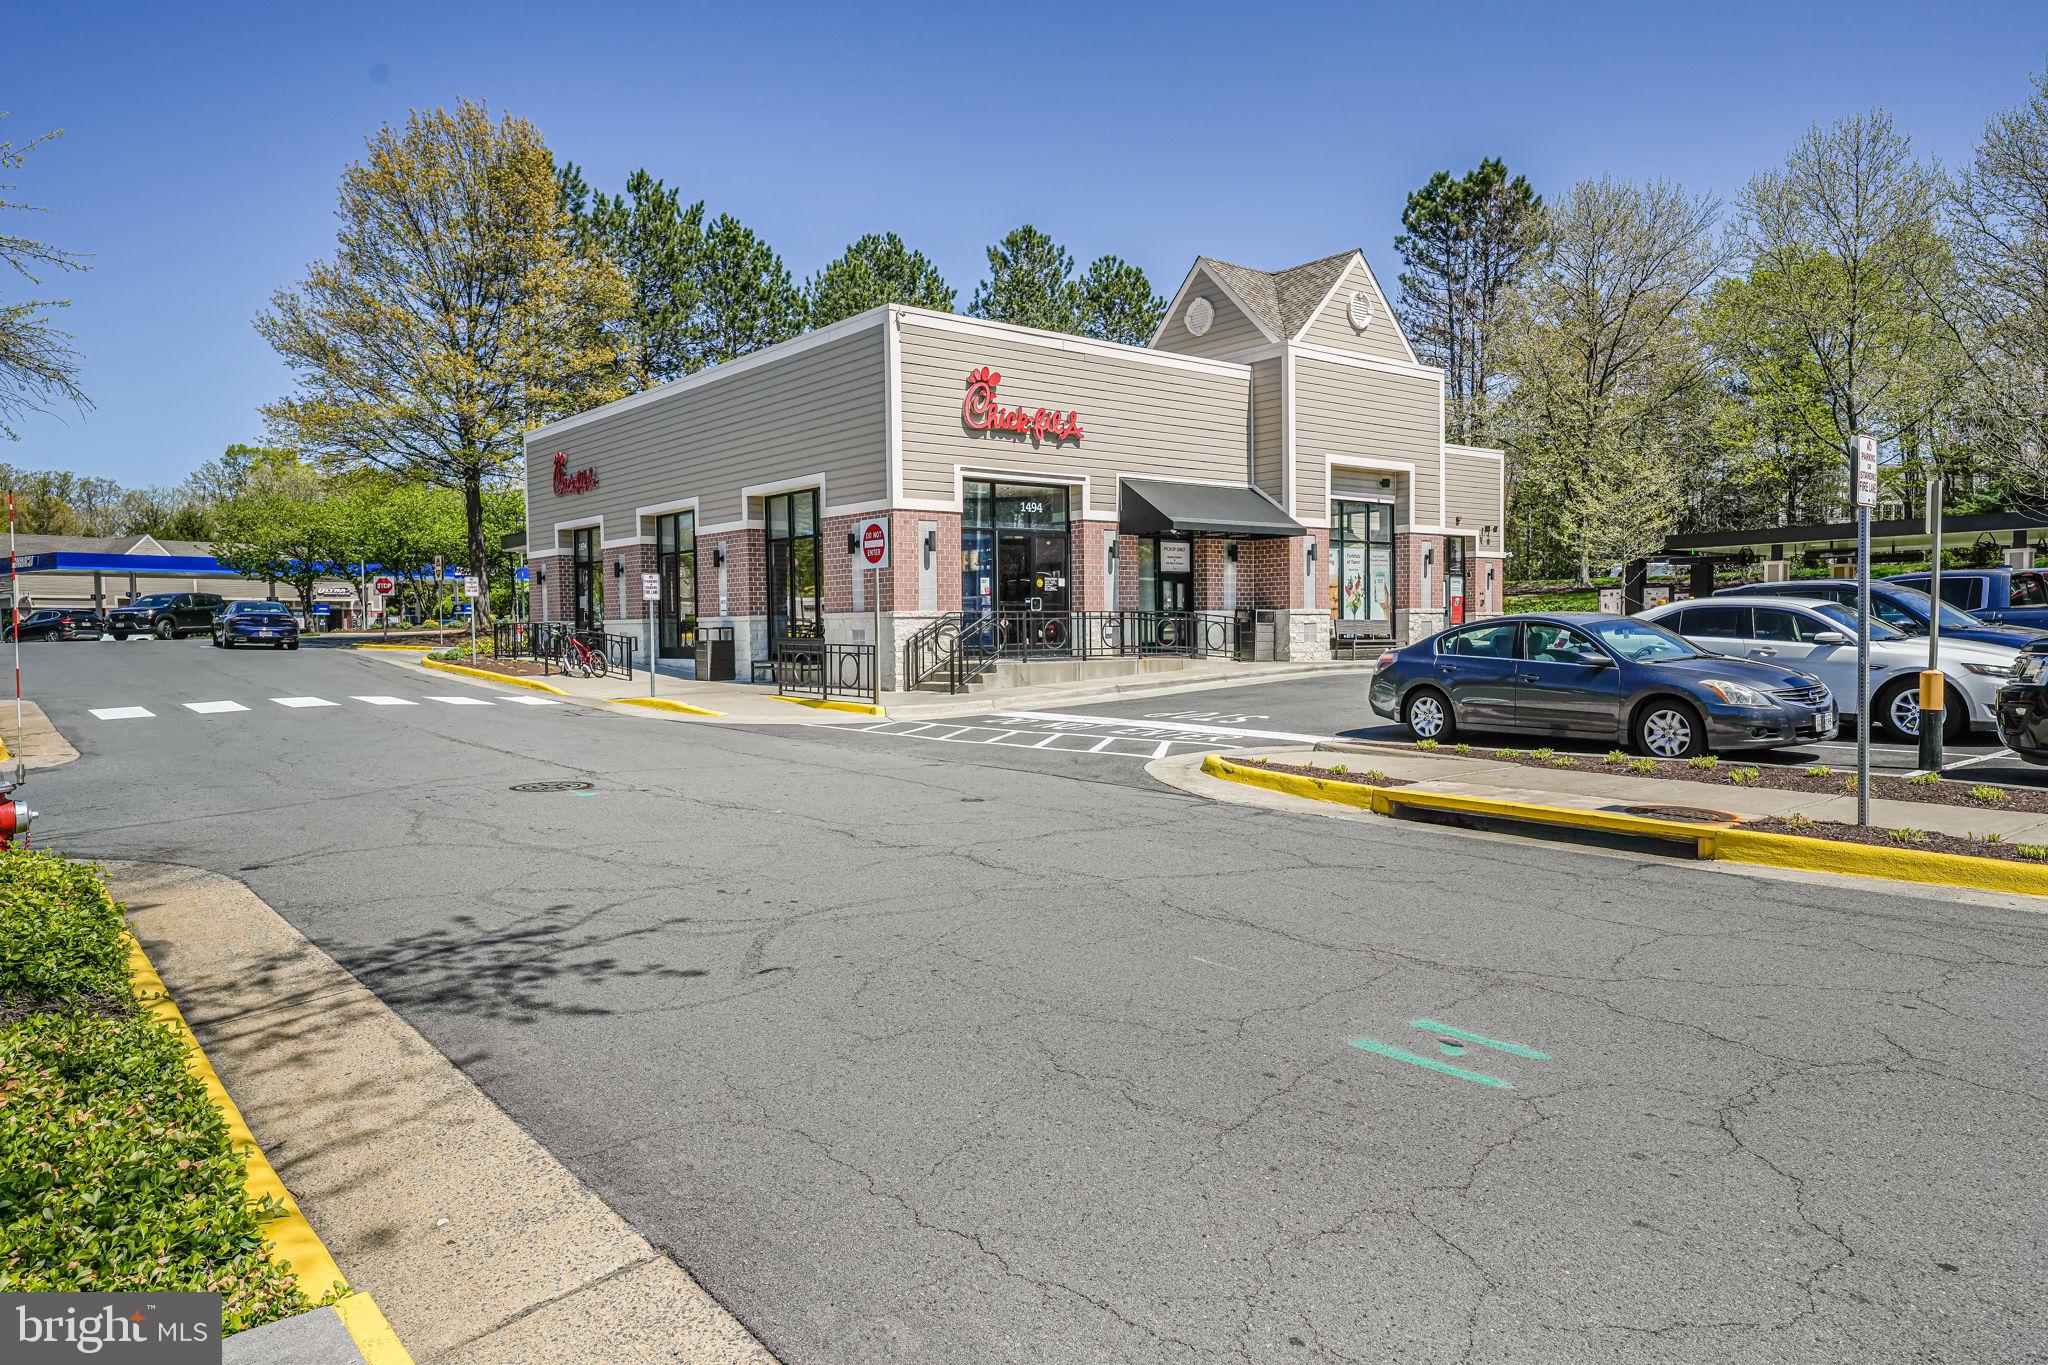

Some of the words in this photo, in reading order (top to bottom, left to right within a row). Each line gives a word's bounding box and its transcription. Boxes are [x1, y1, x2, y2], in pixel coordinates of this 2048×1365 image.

[962, 367, 1084, 440] Chick-fil-A
[1861, 452, 1876, 462] PARKING
[1860, 470, 1876, 480] STANDING
[1860, 481, 1868, 492] FIRE
[1020, 502, 1043, 513] 1494
[873, 531, 882, 539] NOT
